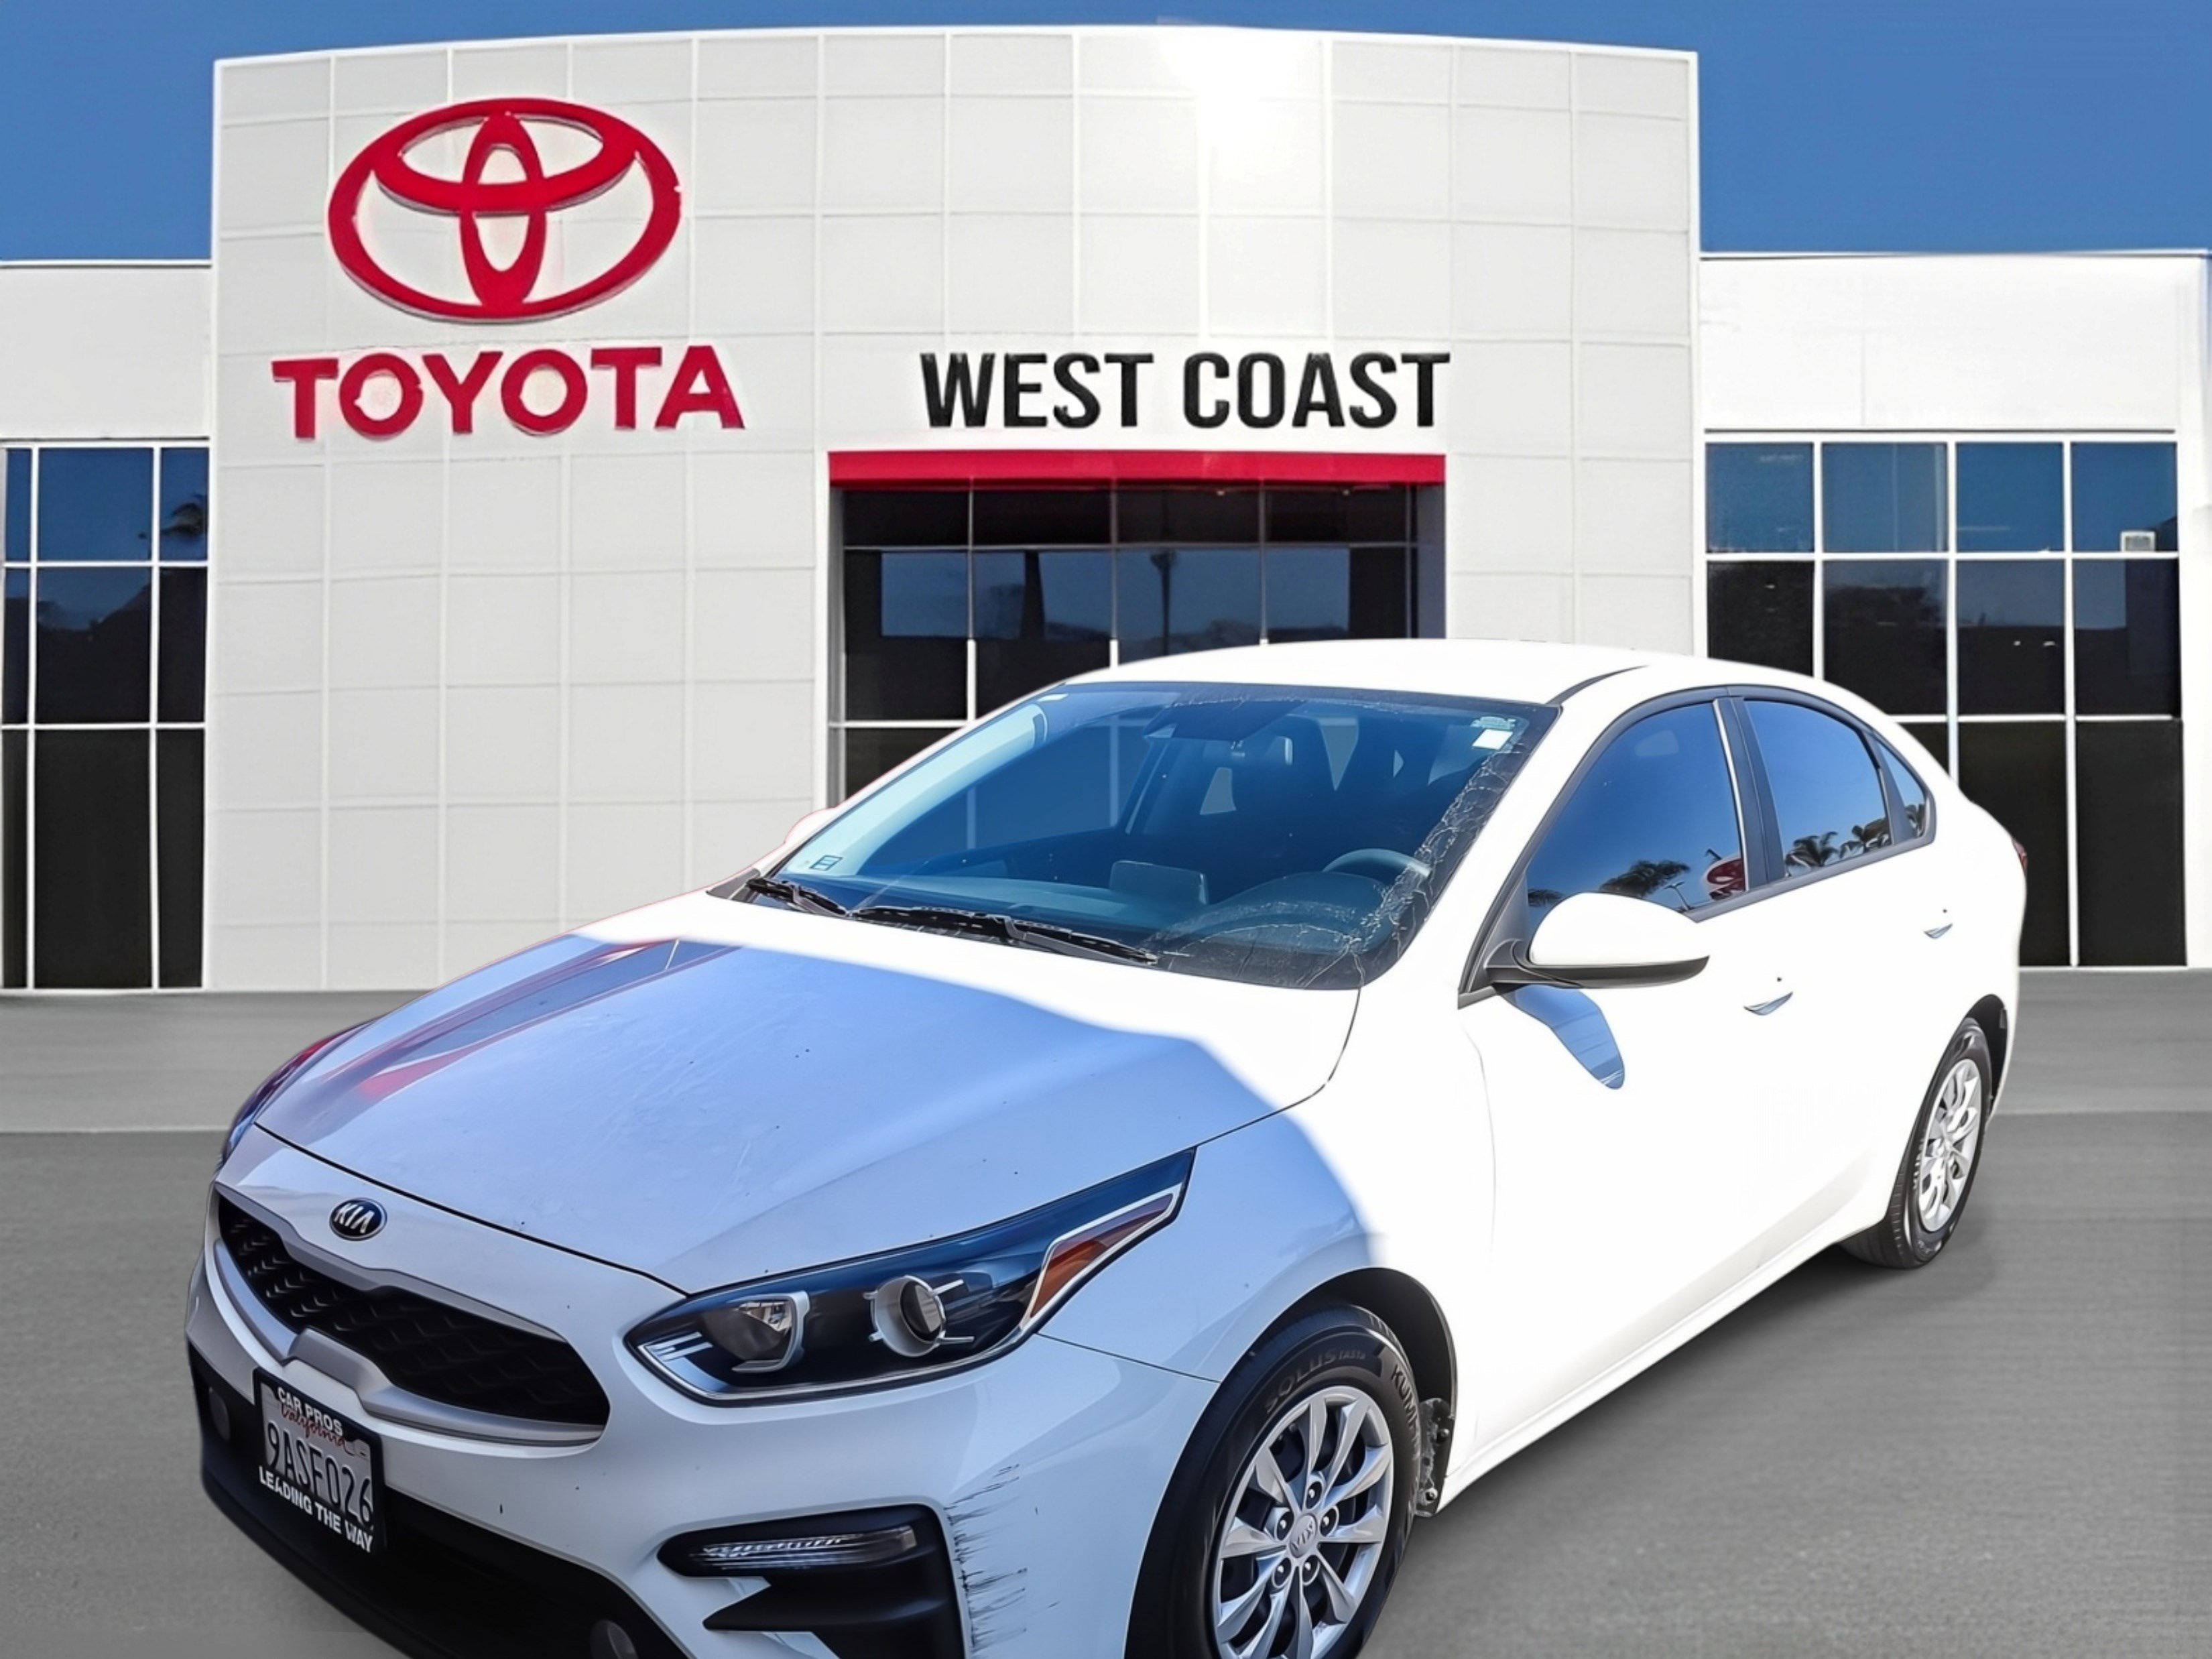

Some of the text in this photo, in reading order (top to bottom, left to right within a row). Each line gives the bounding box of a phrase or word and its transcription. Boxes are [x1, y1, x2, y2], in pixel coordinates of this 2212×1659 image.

[271, 345, 746, 440] TOYOTA
[920, 352, 1451, 430] WEST COAST
[333, 1202, 375, 1234] KIA
[277, 1386, 343, 1436] CAR PROS
[258, 1465, 373, 1554] LEADING THE WAY
[267, 1420, 374, 1529] 9ASF026
